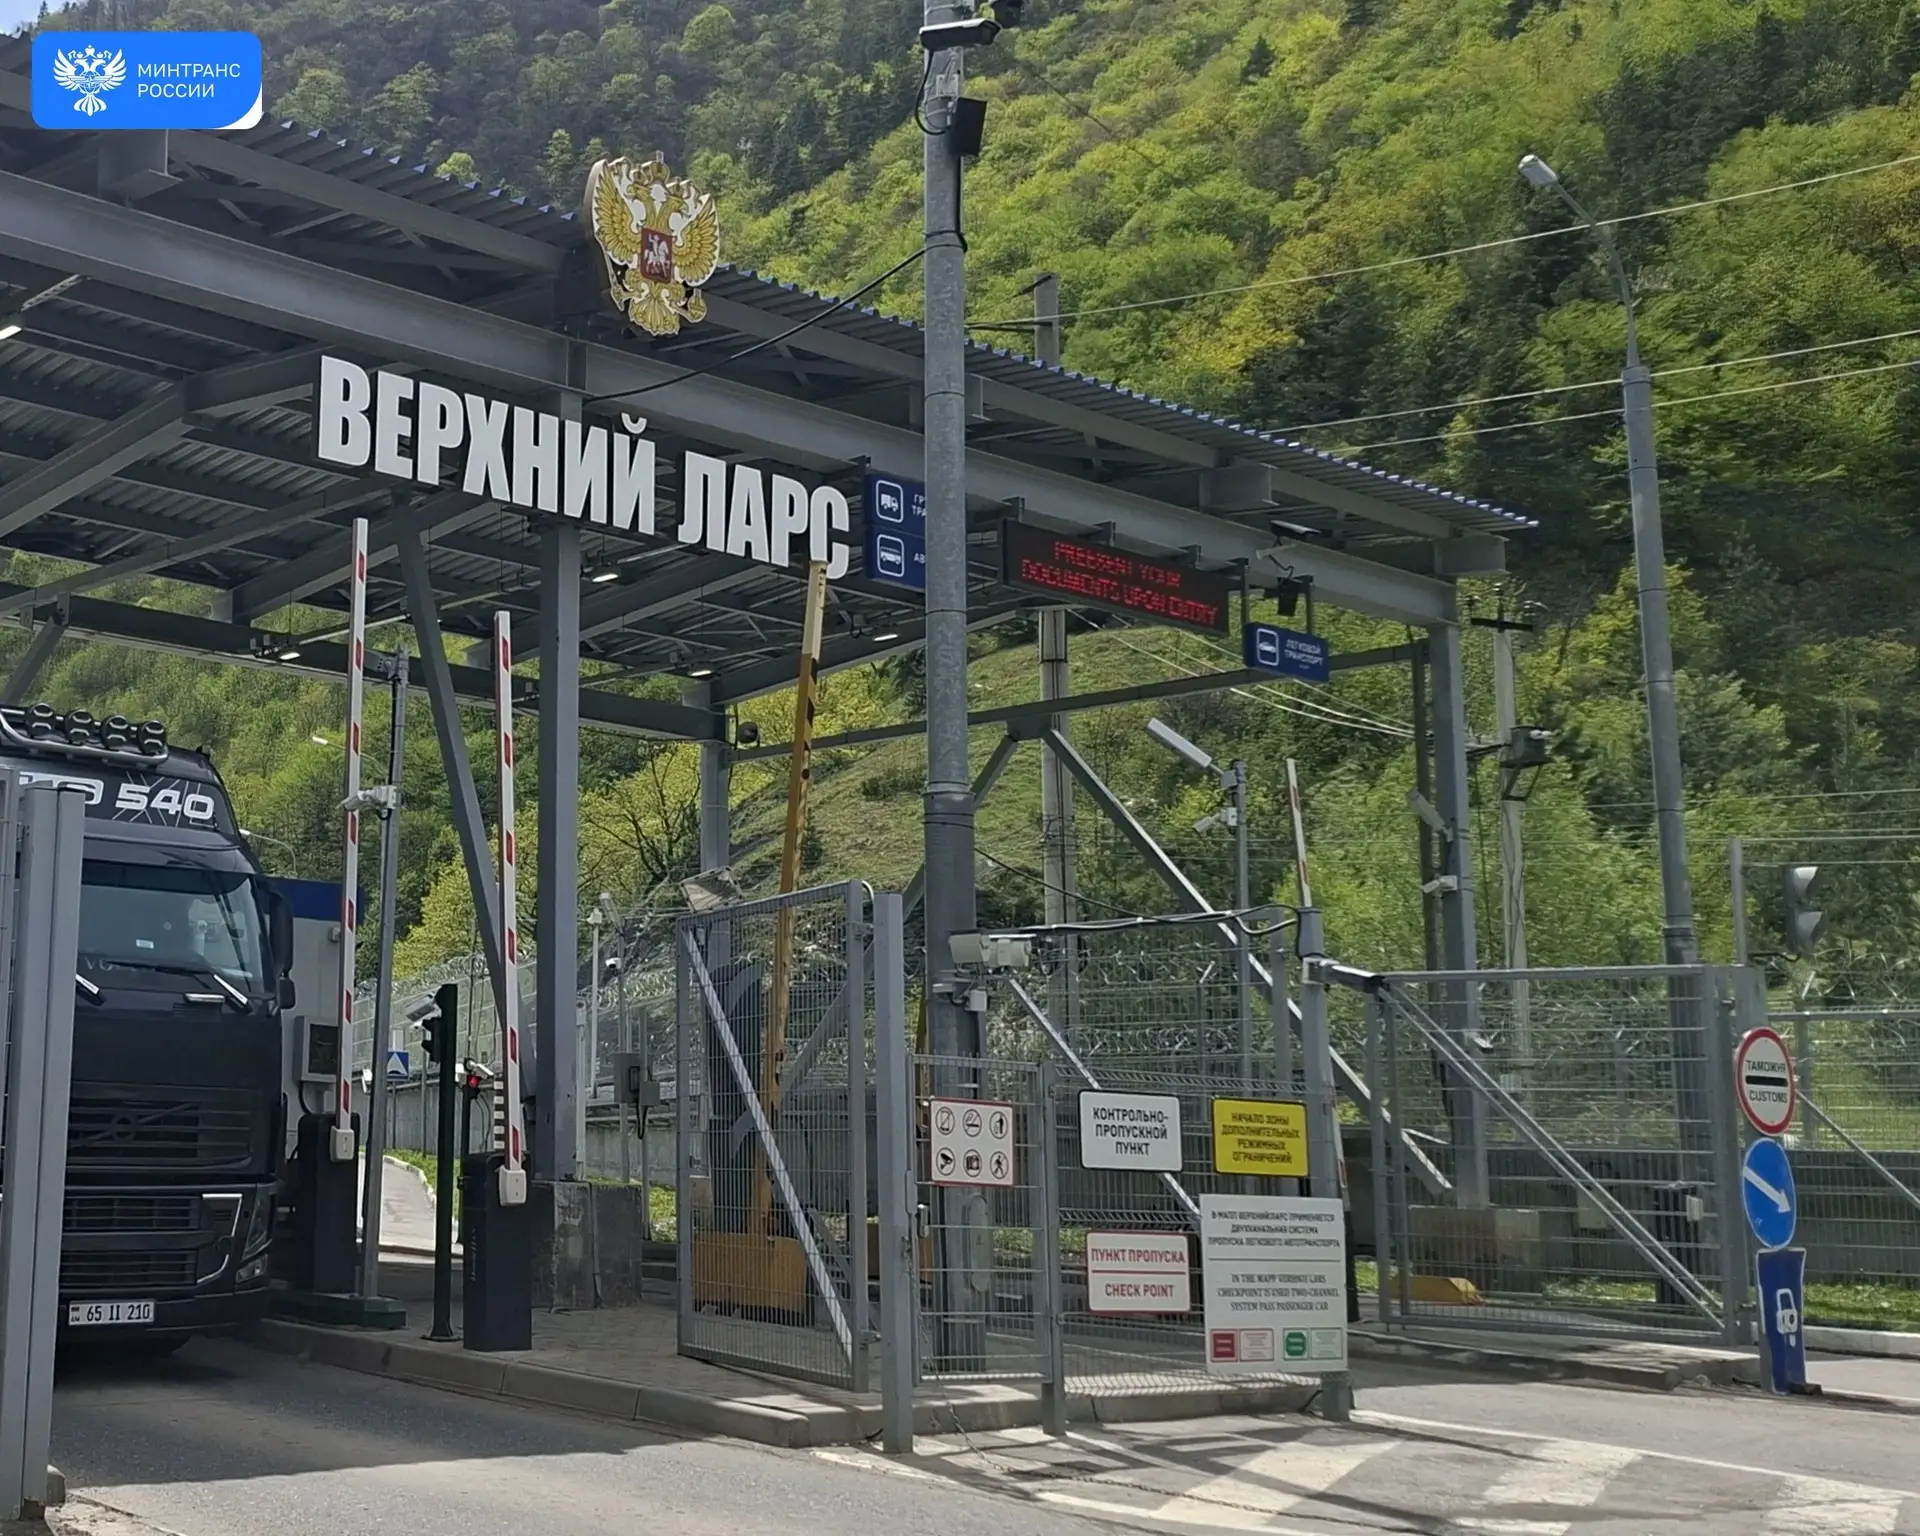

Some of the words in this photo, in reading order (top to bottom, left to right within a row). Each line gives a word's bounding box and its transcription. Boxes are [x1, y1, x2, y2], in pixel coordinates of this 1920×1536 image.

[318, 354, 656, 535] ВЕРХНИЙ
[678, 450, 850, 580] ЛАРС
[115, 782, 215, 820] 540
[1746, 1060, 1786, 1073] ТАМОЖНЯ
[1749, 1090, 1787, 1104] CUSTOMS
[1092, 1107, 1168, 1123] КОНТРОЛЬНО-
[1095, 1124, 1168, 1140] ПРОПУСКНОЙ
[1115, 1141, 1151, 1156] ПУНКТ
[1091, 1248, 1127, 1262] ПУНКТ
[1128, 1249, 1185, 1264] ПРОПУСКА
[1104, 1283, 1141, 1297] CHECK
[1143, 1284, 1175, 1298] POINT
[86, 1305, 102, 1322] 65
[127, 1303, 150, 1320] 210
